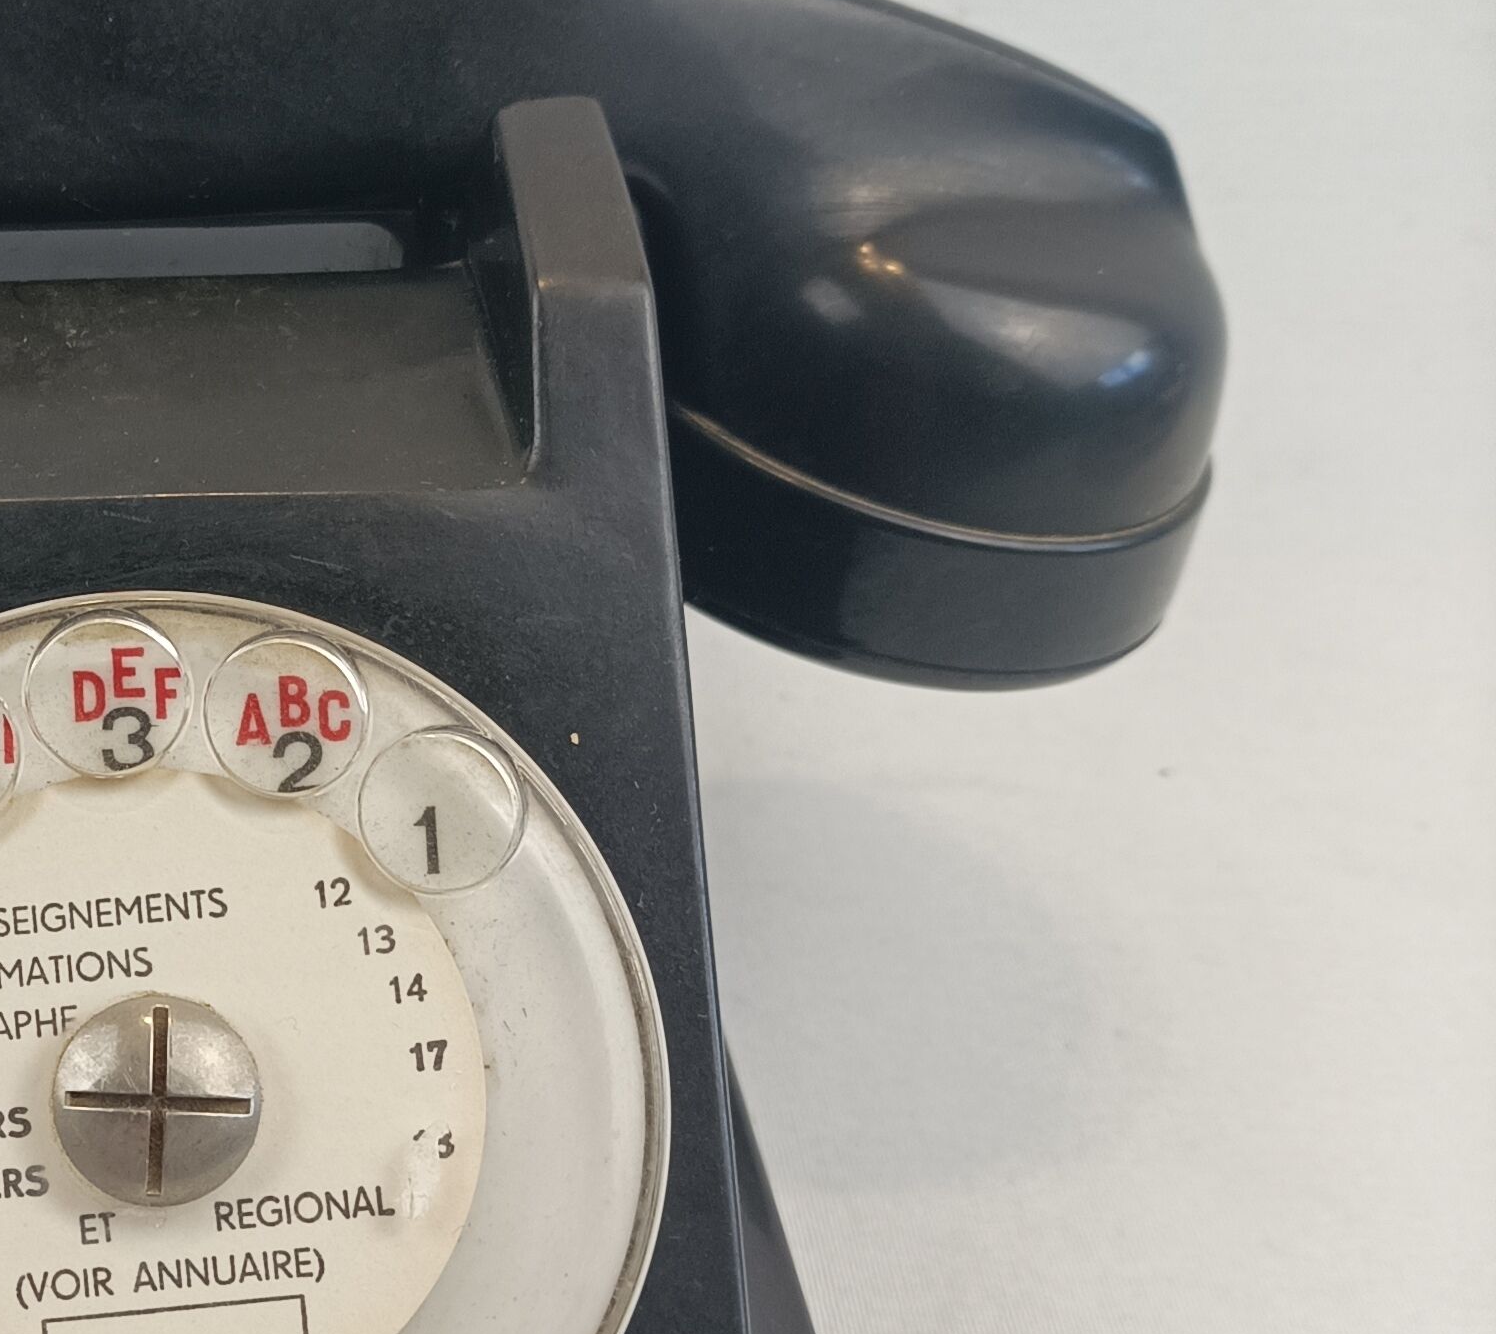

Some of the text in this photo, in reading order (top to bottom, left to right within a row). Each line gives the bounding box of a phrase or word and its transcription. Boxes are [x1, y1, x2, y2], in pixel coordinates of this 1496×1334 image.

[72, 648, 181, 722] DEF
[236, 676, 351, 745] ABC
[102, 707, 157, 771] 3
[272, 732, 324, 793] 2
[414, 806, 440, 875] 1
[314, 877, 352, 909] 12
[357, 924, 396, 955] 13
[389, 973, 427, 1004] 14
[409, 1039, 447, 1072] 17
[78, 1211, 116, 1245] ET
[214, 1185, 396, 1232] REGIONAL
[16, 1247, 326, 1310] (VOIR ANNUAIRE)
